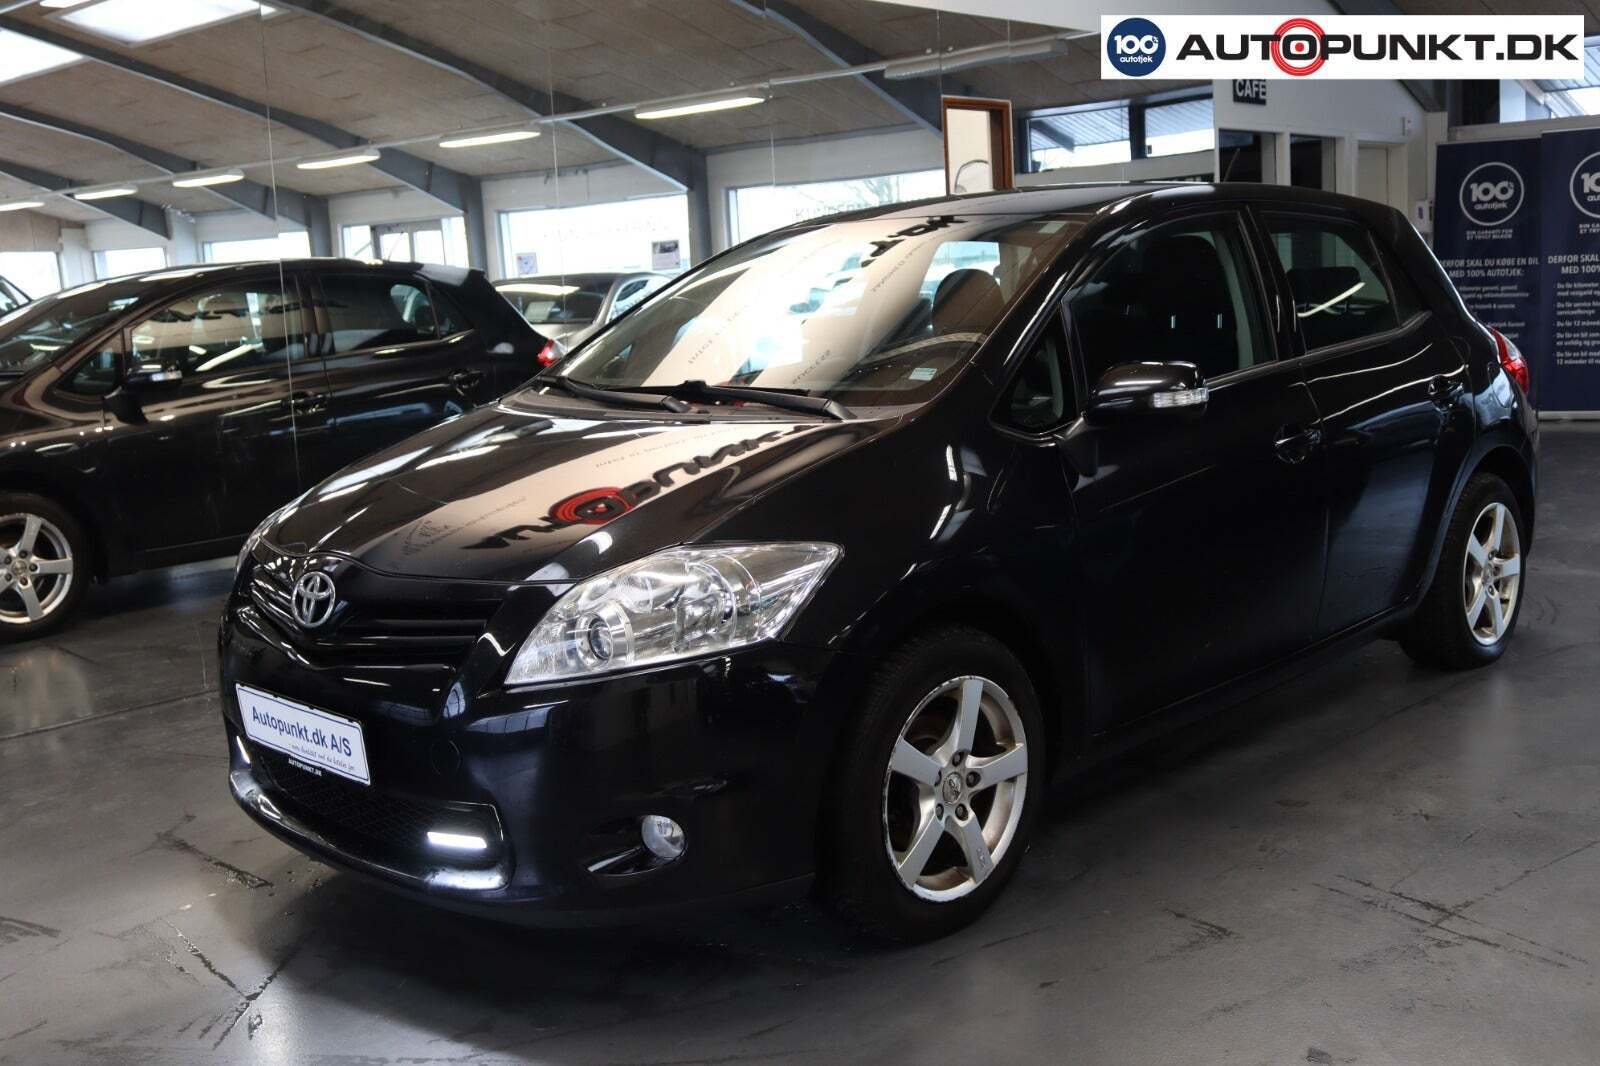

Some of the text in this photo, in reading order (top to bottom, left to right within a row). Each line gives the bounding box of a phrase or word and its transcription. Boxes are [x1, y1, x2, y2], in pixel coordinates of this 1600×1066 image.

[1466, 258, 1483, 267] SKAL
[1484, 258, 1495, 266] DU
[1516, 257, 1527, 265] EN
[1548, 253, 1600, 264] DERFOR SKAL
[1449, 270, 1465, 278] MED
[1561, 265, 1579, 274] MED
[252, 705, 328, 749] Autopunkt.dk
[331, 733, 352, 757] A/S
